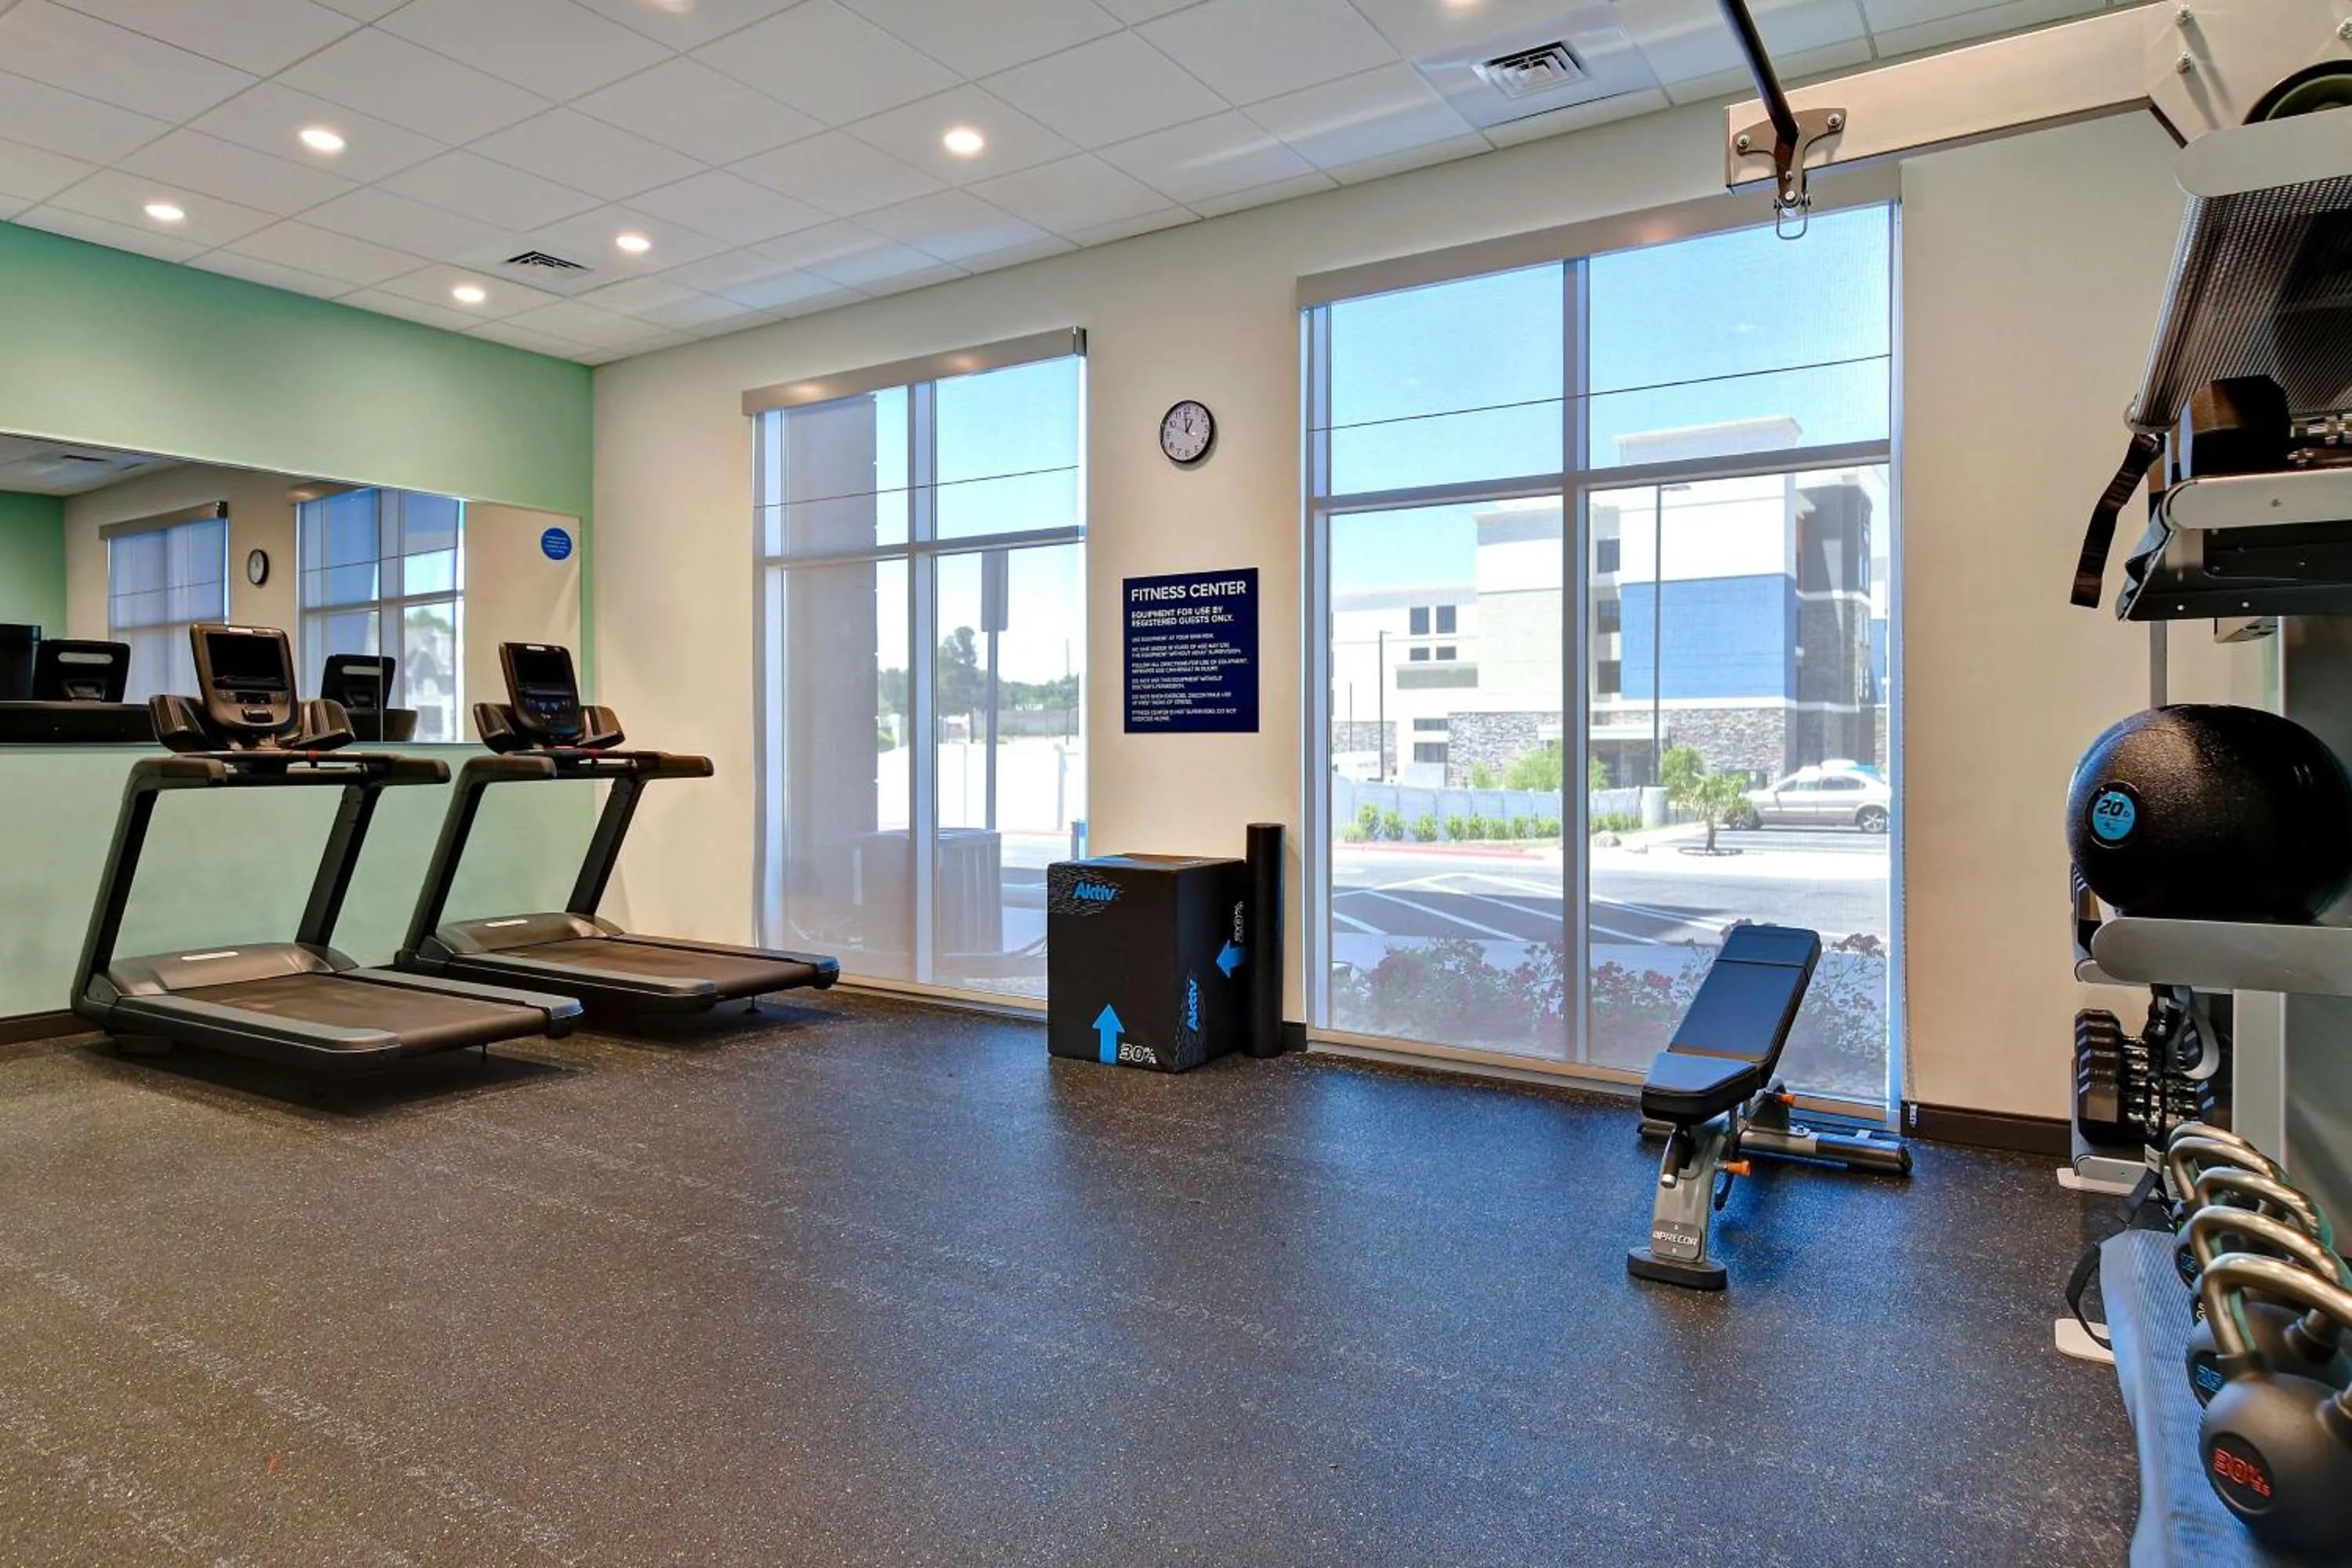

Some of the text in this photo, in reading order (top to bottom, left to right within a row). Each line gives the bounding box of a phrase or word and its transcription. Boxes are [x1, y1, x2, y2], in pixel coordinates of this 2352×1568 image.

[1131, 580, 1246, 601] FITNESS CENTER
[1131, 605, 1223, 619] EQUIPMENT FOR USE BY
[1131, 617, 1176, 627] REGISTERED
[1179, 615, 1209, 624] GUESTS
[2098, 799, 2124, 816] 20
[1073, 881, 1116, 902] Aktiv
[1186, 978, 1198, 1031] Aktiv
[1658, 1232, 1697, 1247] PRECOR
